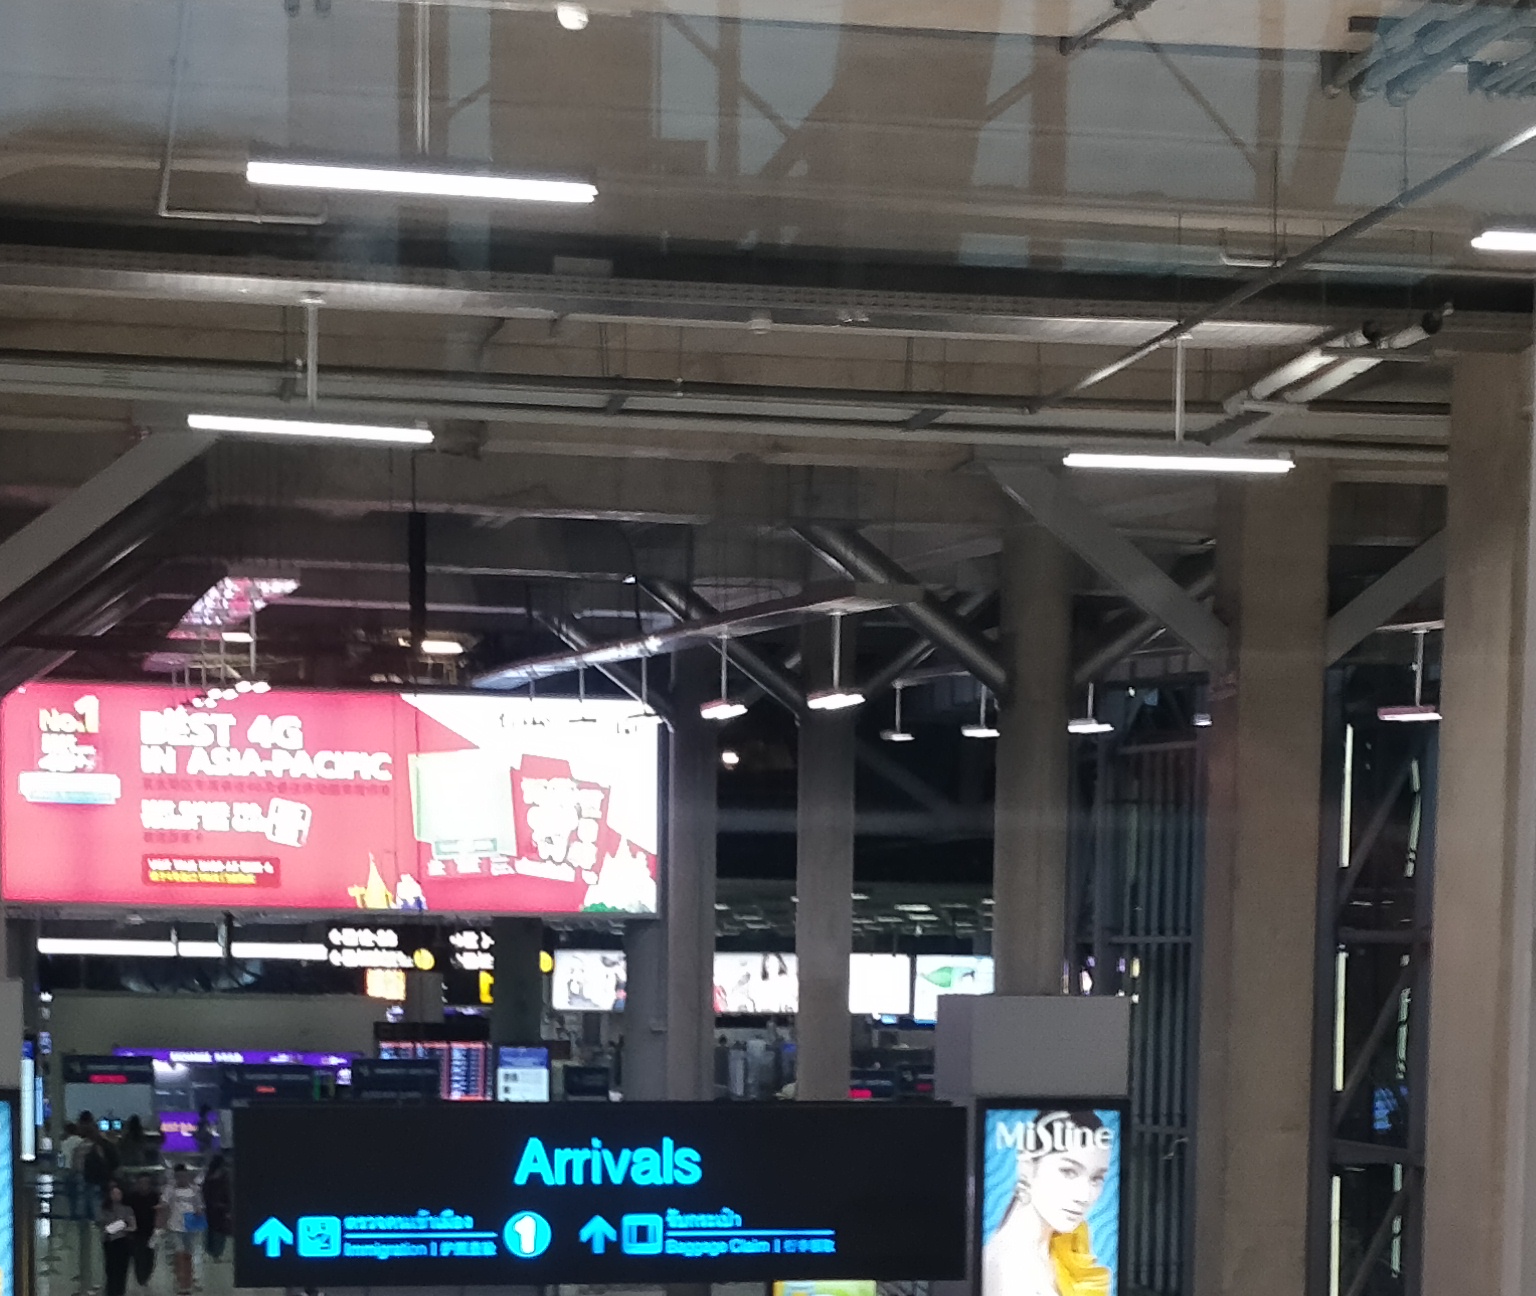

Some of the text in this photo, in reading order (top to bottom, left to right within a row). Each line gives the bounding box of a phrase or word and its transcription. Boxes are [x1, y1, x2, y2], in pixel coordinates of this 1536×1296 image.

[139, 709, 304, 750] BEST 4G
[139, 747, 393, 782] IN ASIA-PACIFIC
[514, 1137, 703, 1187] Arrivals
[513, 1214, 537, 1256] 1
